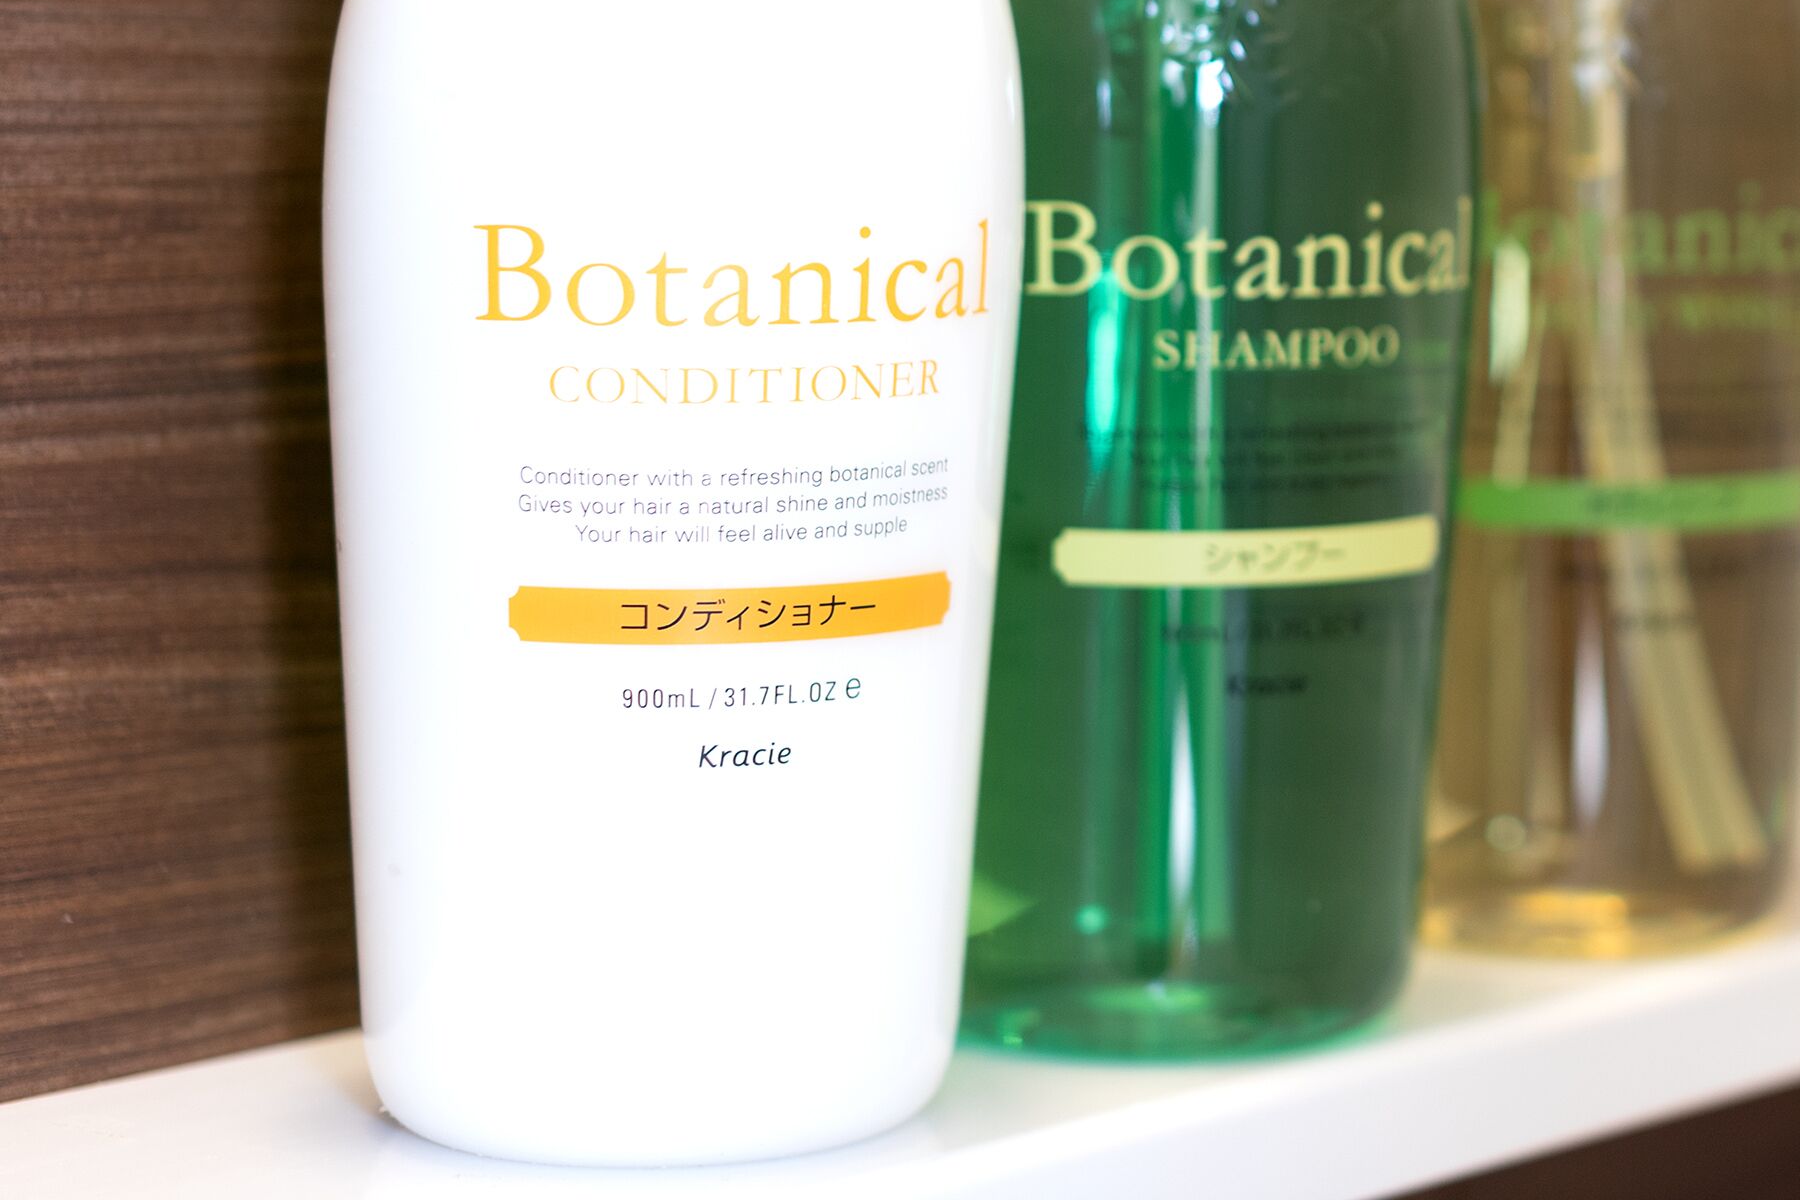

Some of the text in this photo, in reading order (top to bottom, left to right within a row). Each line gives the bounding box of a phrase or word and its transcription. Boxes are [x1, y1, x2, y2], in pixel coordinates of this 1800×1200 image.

[1025, 196, 1472, 300] Botanical
[471, 217, 991, 327] Botanical
[1153, 325, 1399, 370] SHAMPOO
[549, 359, 939, 405] CONDITIONER
[520, 458, 948, 487] Conditioner with a refreshing botanical scent
[519, 487, 947, 517] Gives your hair a natural shine and moistness
[575, 516, 907, 543] Your hair will feel alive and supple
[621, 595, 876, 632] コンディショナー
[623, 688, 700, 708] 900mL
[709, 688, 717, 710] /
[724, 681, 836, 707] 31.7FL.OZ
[699, 742, 792, 768] Kracie
